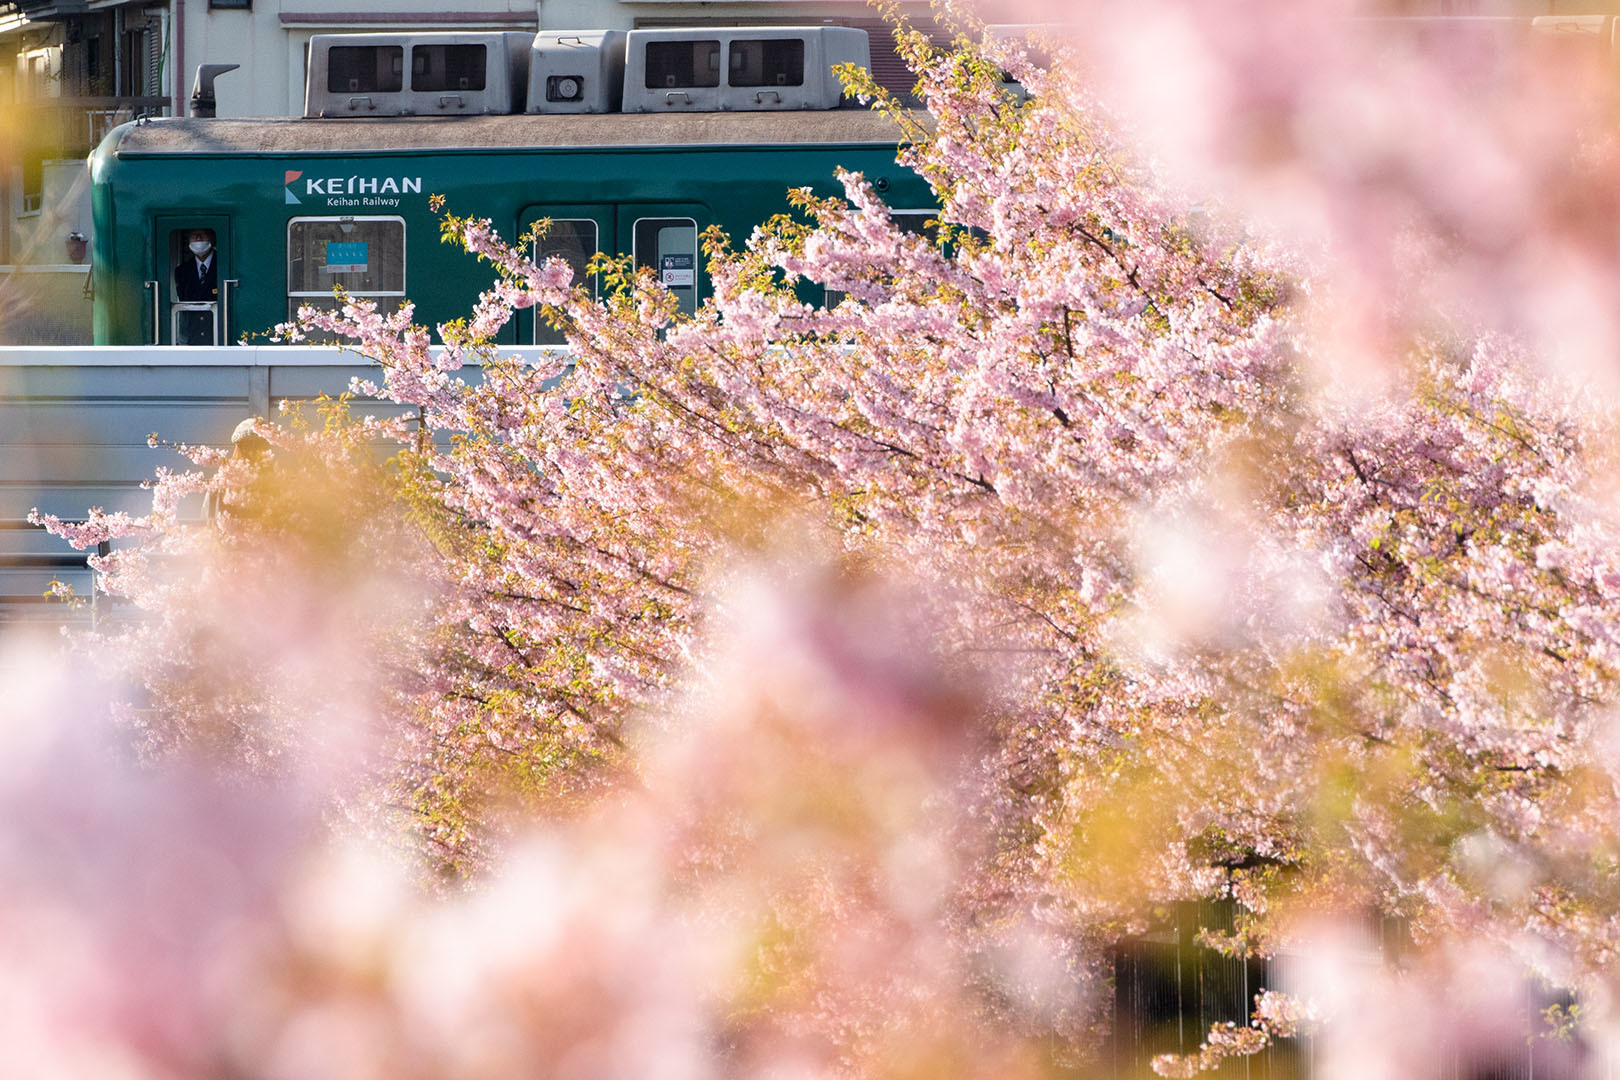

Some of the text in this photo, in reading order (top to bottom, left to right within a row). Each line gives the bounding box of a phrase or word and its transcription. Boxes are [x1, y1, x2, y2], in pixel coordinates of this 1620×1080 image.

[306, 175, 421, 194] KEIHAN
[327, 197, 400, 207] Keihan Railway
